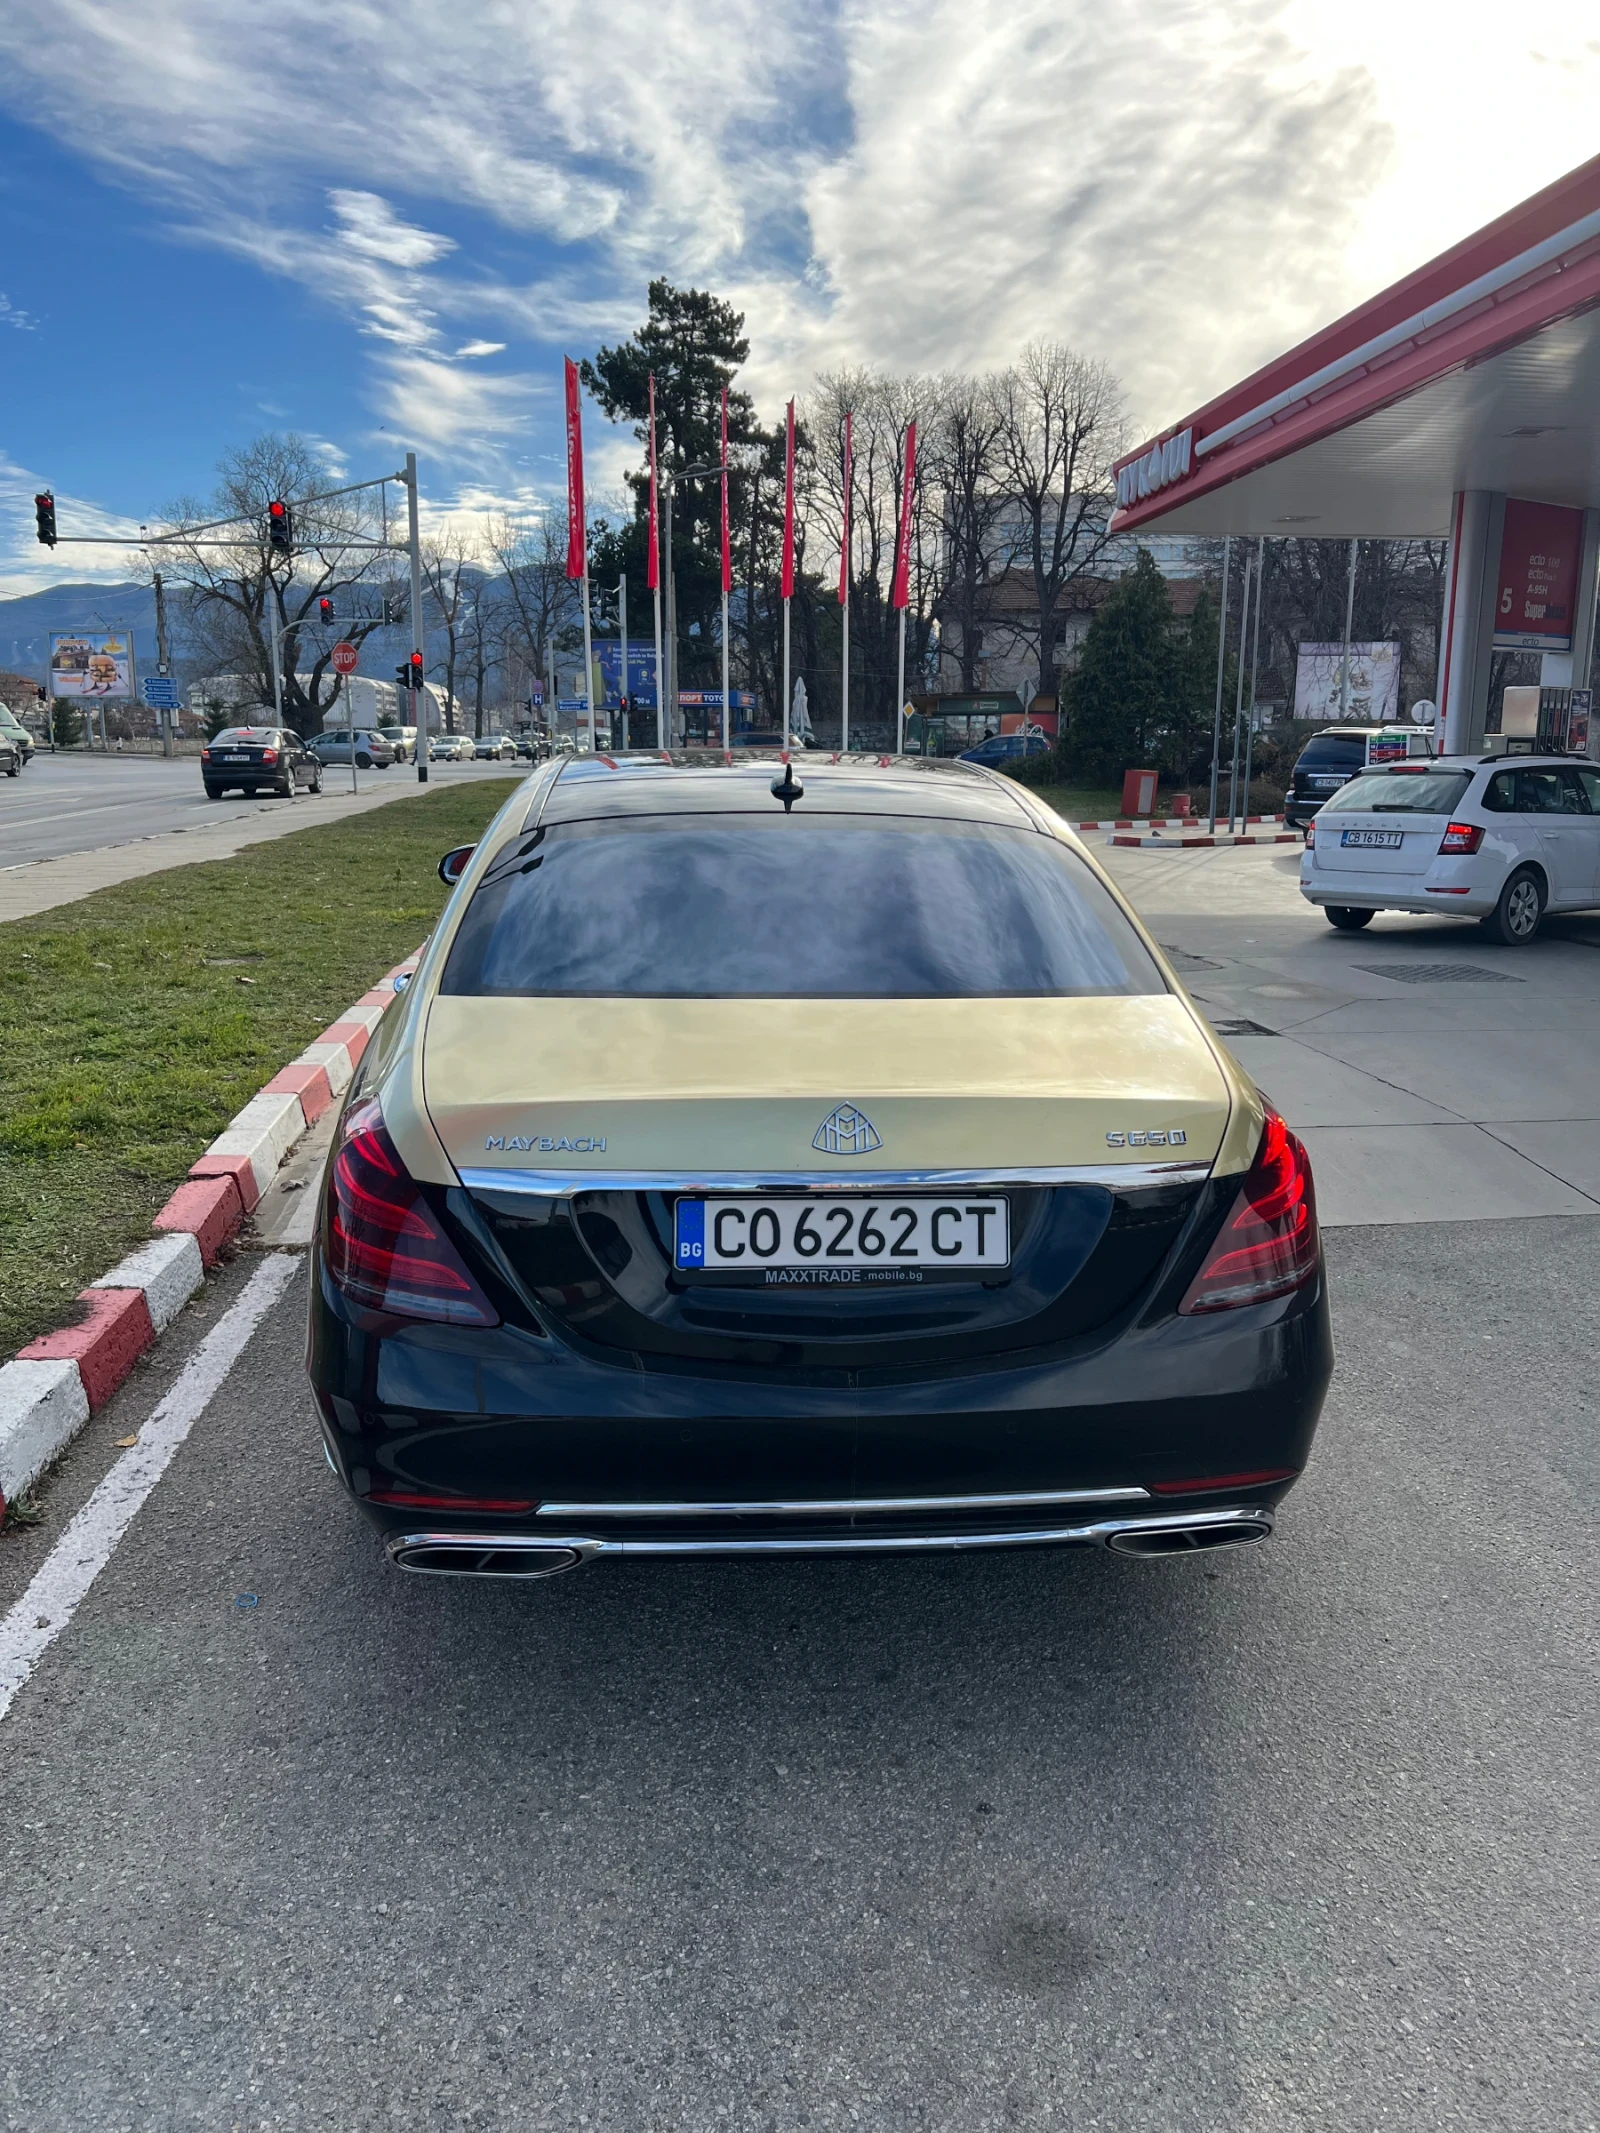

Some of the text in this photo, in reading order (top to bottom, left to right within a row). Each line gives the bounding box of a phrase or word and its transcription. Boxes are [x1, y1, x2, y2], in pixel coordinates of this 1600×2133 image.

[1529, 554, 1545, 566] ecto
[1527, 568, 1544, 580] ecto
[1501, 587, 1512, 613] 5
[1525, 600, 1546, 620] Super
[334, 653, 355, 664] STOP
[534, 694, 542, 704] H
[1348, 832, 1400, 844] CB 1615 TT
[484, 1135, 607, 1152] MAYBACH
[714, 1206, 997, 1258] CO 6262 CT
[680, 1242, 702, 1258] BG
[765, 1270, 861, 1283] MAXXTRADE
